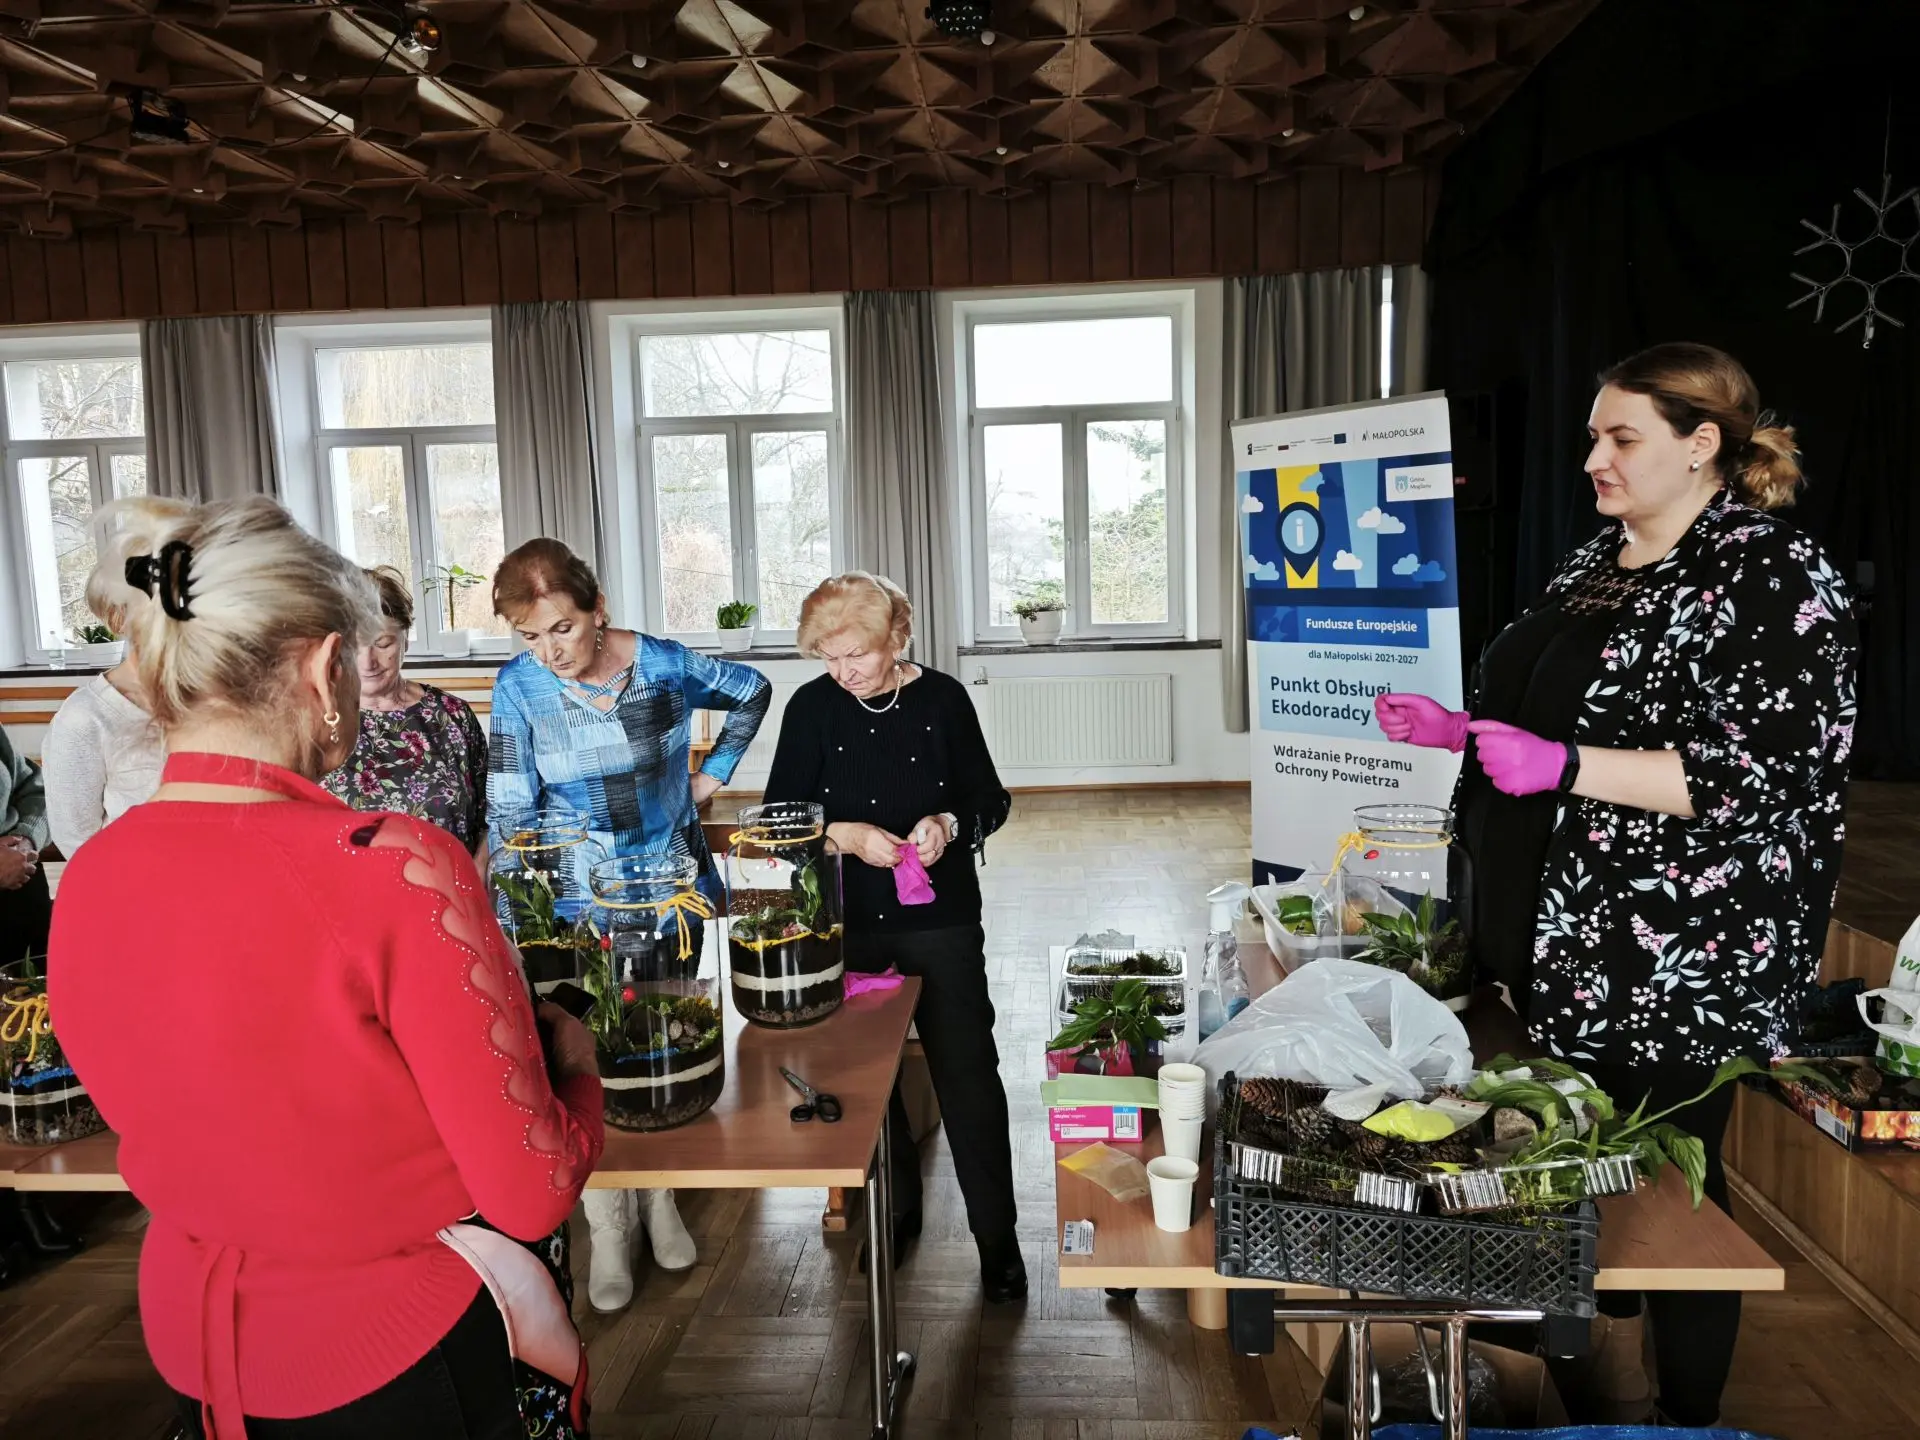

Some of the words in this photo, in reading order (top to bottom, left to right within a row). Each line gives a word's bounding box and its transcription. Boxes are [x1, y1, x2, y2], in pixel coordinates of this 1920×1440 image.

[1372, 427, 1425, 440] MAŁOPOLSKA
[1306, 618, 1354, 630] Fundusze
[1356, 619, 1418, 633] Europejskie
[1308, 650, 1322, 659] dla
[1324, 651, 1373, 663] Małopolski
[1375, 653, 1419, 664] 2021-2027
[1270, 676, 1321, 694] Punkt
[1272, 699, 1371, 725] Ekodoradcy
[1273, 744, 1341, 763] Wdrażanie
[1345, 752, 1413, 772] Programu
[1275, 762, 1329, 781] Ochrony
[1332, 769, 1399, 788] Powietrza
